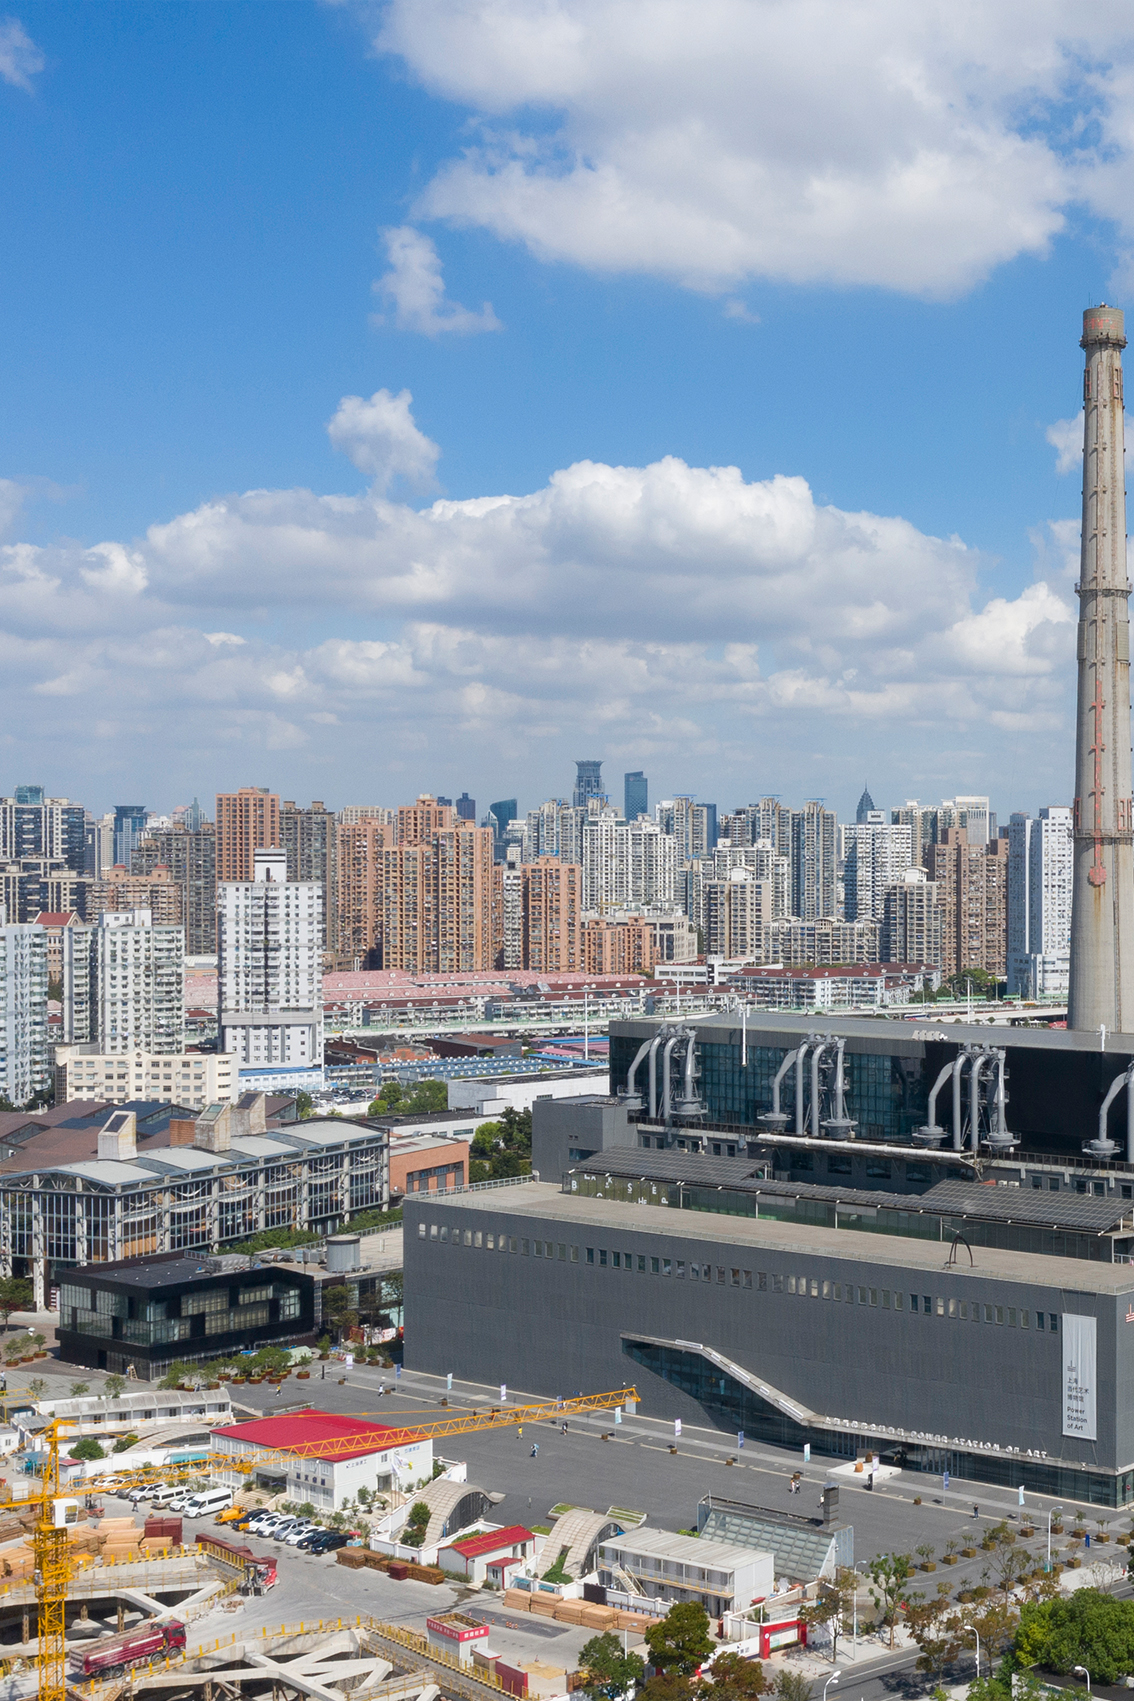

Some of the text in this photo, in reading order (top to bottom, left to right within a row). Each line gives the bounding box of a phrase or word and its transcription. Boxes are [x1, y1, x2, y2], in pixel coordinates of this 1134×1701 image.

[1067, 1406, 1085, 1415] Power
[1067, 1414, 1088, 1424] Station
[952, 1437, 1000, 1452] STATION
[1025, 1448, 1047, 1459] ART
